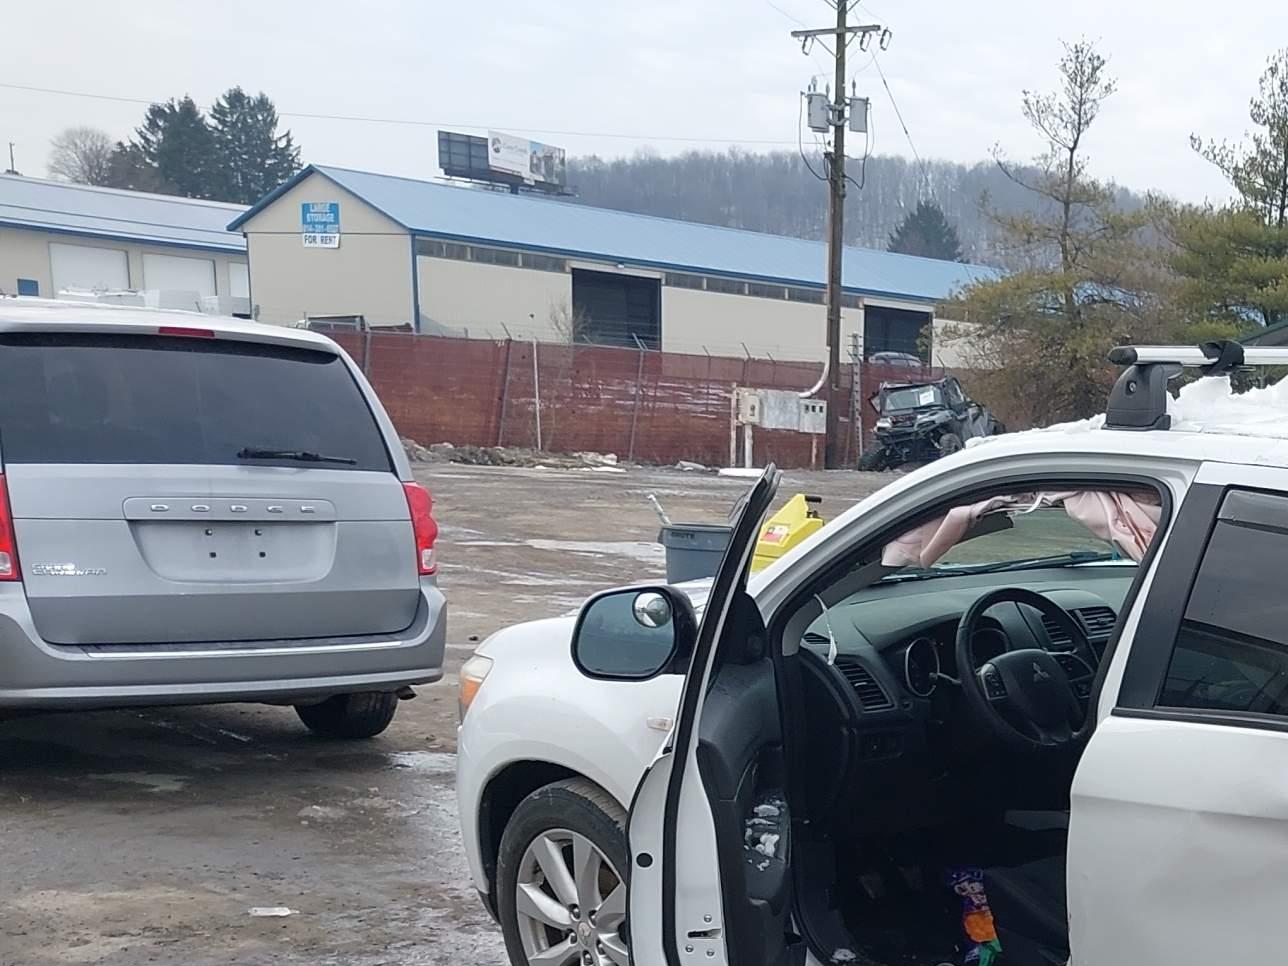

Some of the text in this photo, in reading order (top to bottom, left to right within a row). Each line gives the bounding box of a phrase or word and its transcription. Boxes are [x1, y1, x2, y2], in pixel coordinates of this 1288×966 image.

[304, 234, 337, 244] FOR RENT
[150, 504, 316, 514] DODGE
